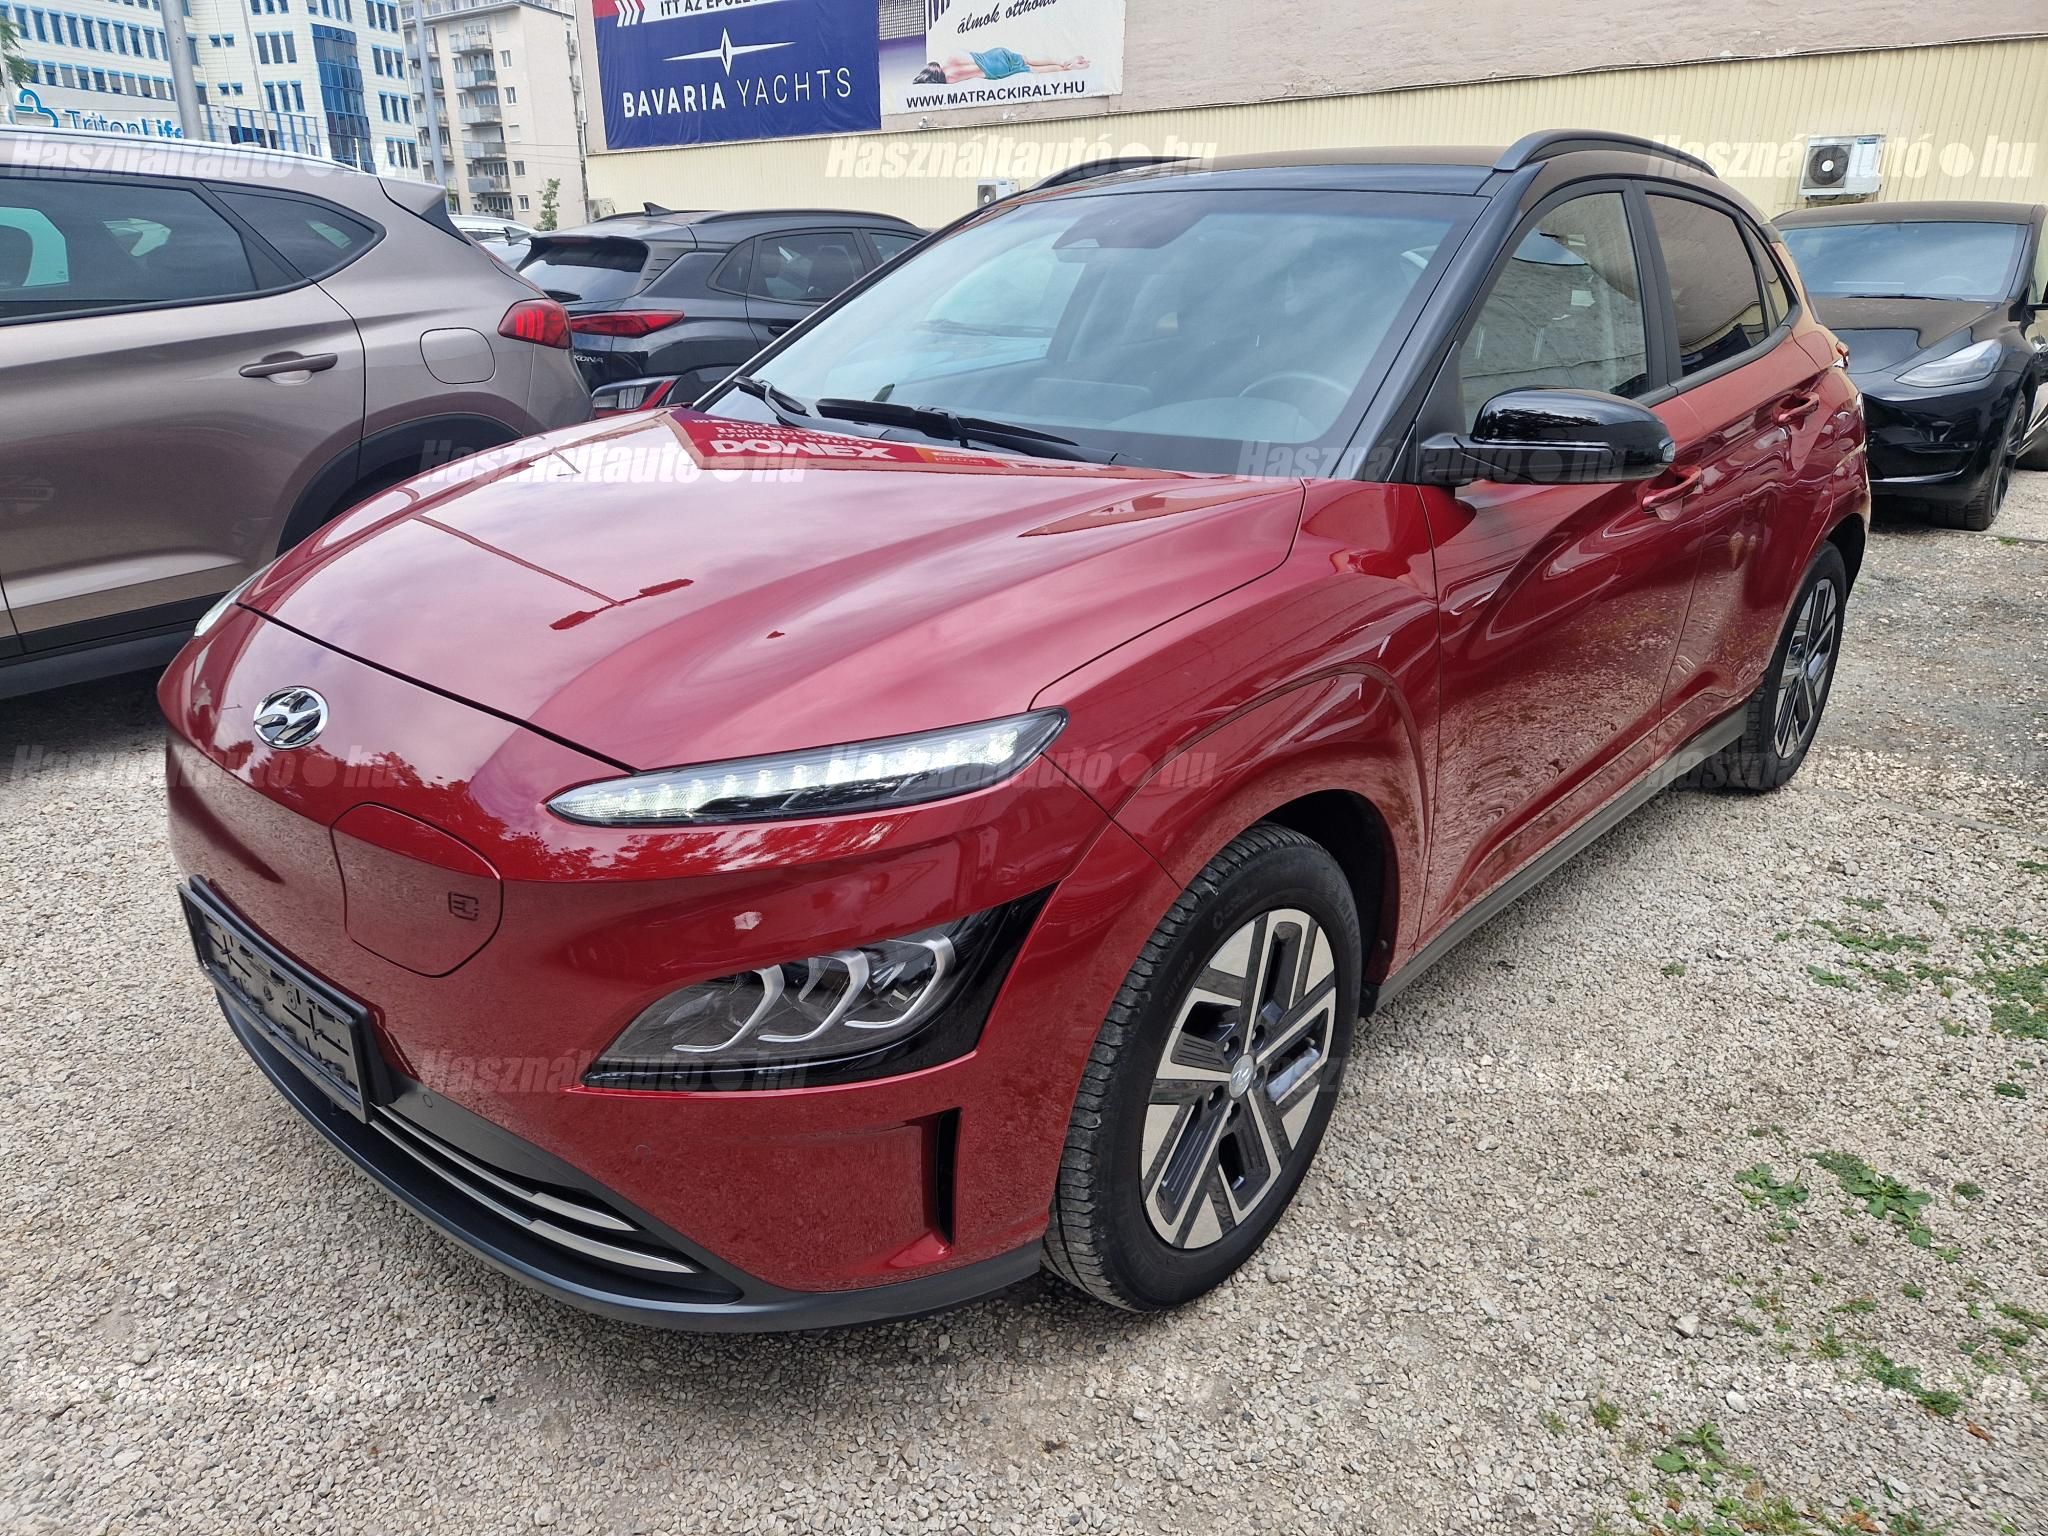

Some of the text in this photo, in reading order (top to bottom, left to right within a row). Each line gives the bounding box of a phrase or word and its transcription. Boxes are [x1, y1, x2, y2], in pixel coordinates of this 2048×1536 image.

[660, 0, 679, 16] ITT
[957, 3, 1000, 34] álmok
[622, 67, 851, 118] BAVARIA YACHTS
[906, 80, 1086, 109] WWW.MATRACKIRALY.HU
[573, 354, 604, 363] KONA
